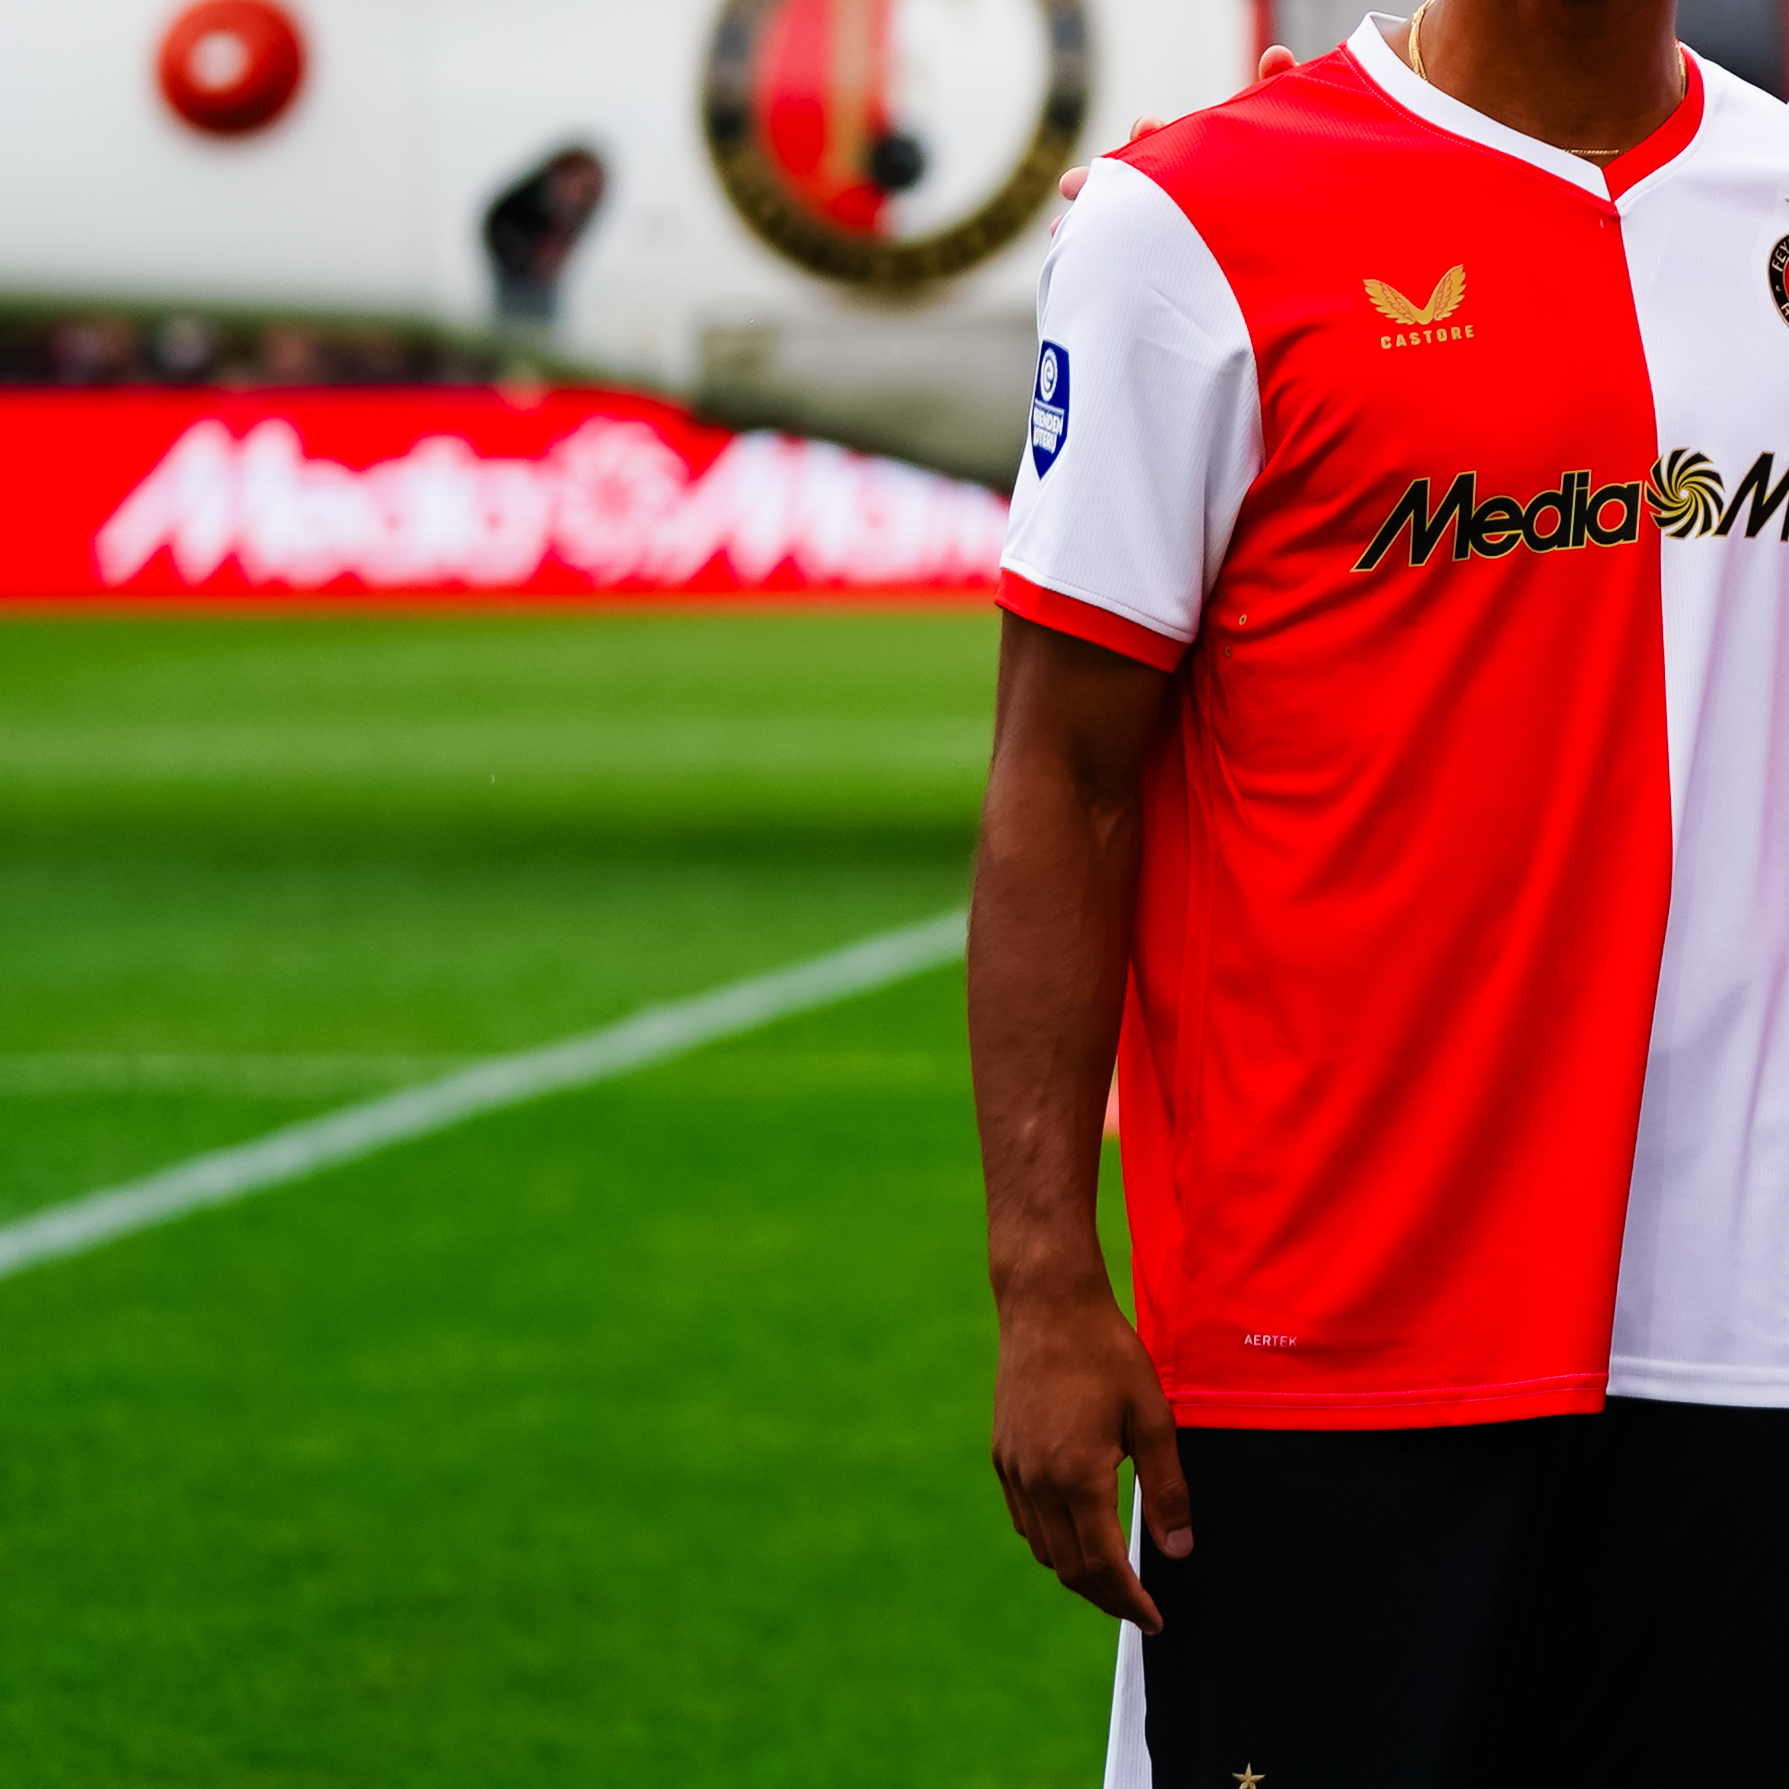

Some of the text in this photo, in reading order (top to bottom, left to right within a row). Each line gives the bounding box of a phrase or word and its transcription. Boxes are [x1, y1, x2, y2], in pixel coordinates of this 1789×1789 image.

[1380, 324, 1475, 350] CASTORE
[1349, 468, 1643, 573] Media
[1244, 1334, 1298, 1348] AERTEK
